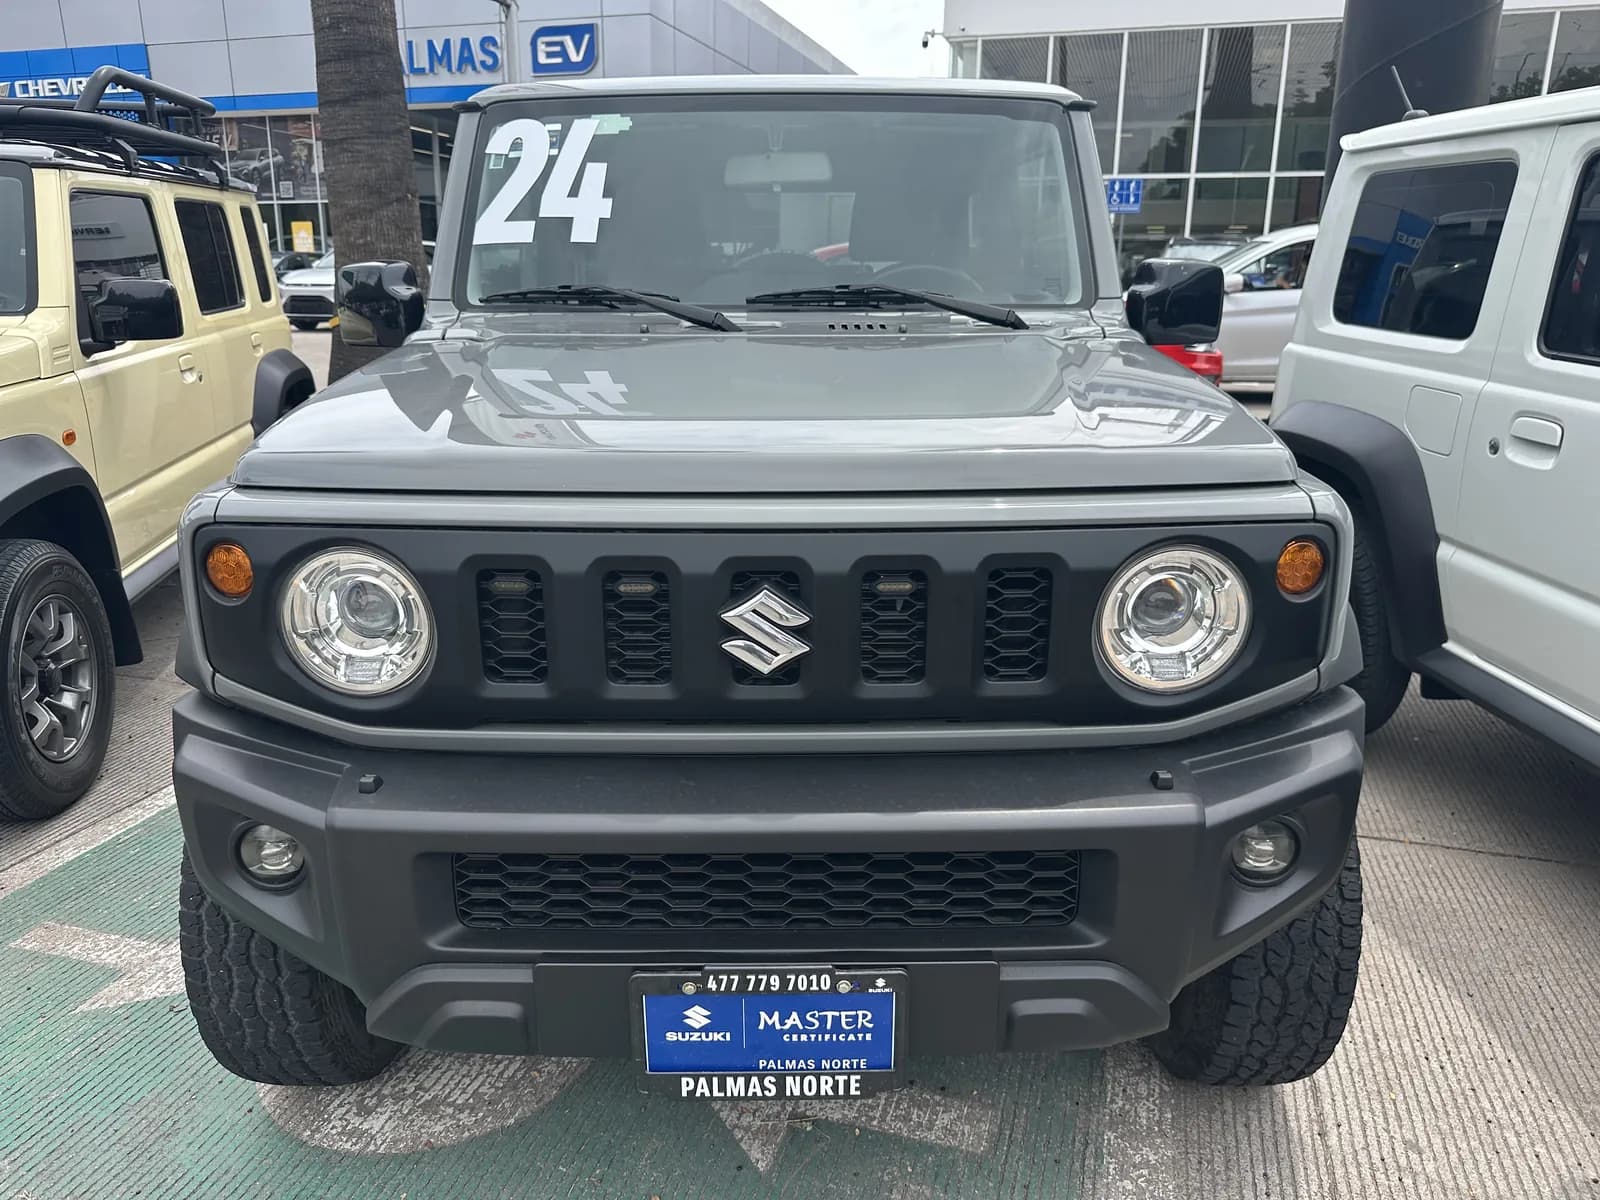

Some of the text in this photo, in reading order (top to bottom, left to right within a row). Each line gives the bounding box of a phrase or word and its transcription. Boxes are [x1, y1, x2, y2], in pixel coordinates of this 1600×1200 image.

[402, 36, 500, 74] LMAS
[537, 34, 590, 64] EV
[472, 118, 613, 245] 24
[707, 974, 831, 991] 477 779 7010
[757, 1010, 874, 1030] MASTER
[665, 1031, 731, 1041] SUZUKI
[783, 1033, 872, 1042] CERTIFICATE
[759, 1058, 867, 1069] PALMAS NORTE
[681, 1075, 861, 1097] PALMAS NORTE
